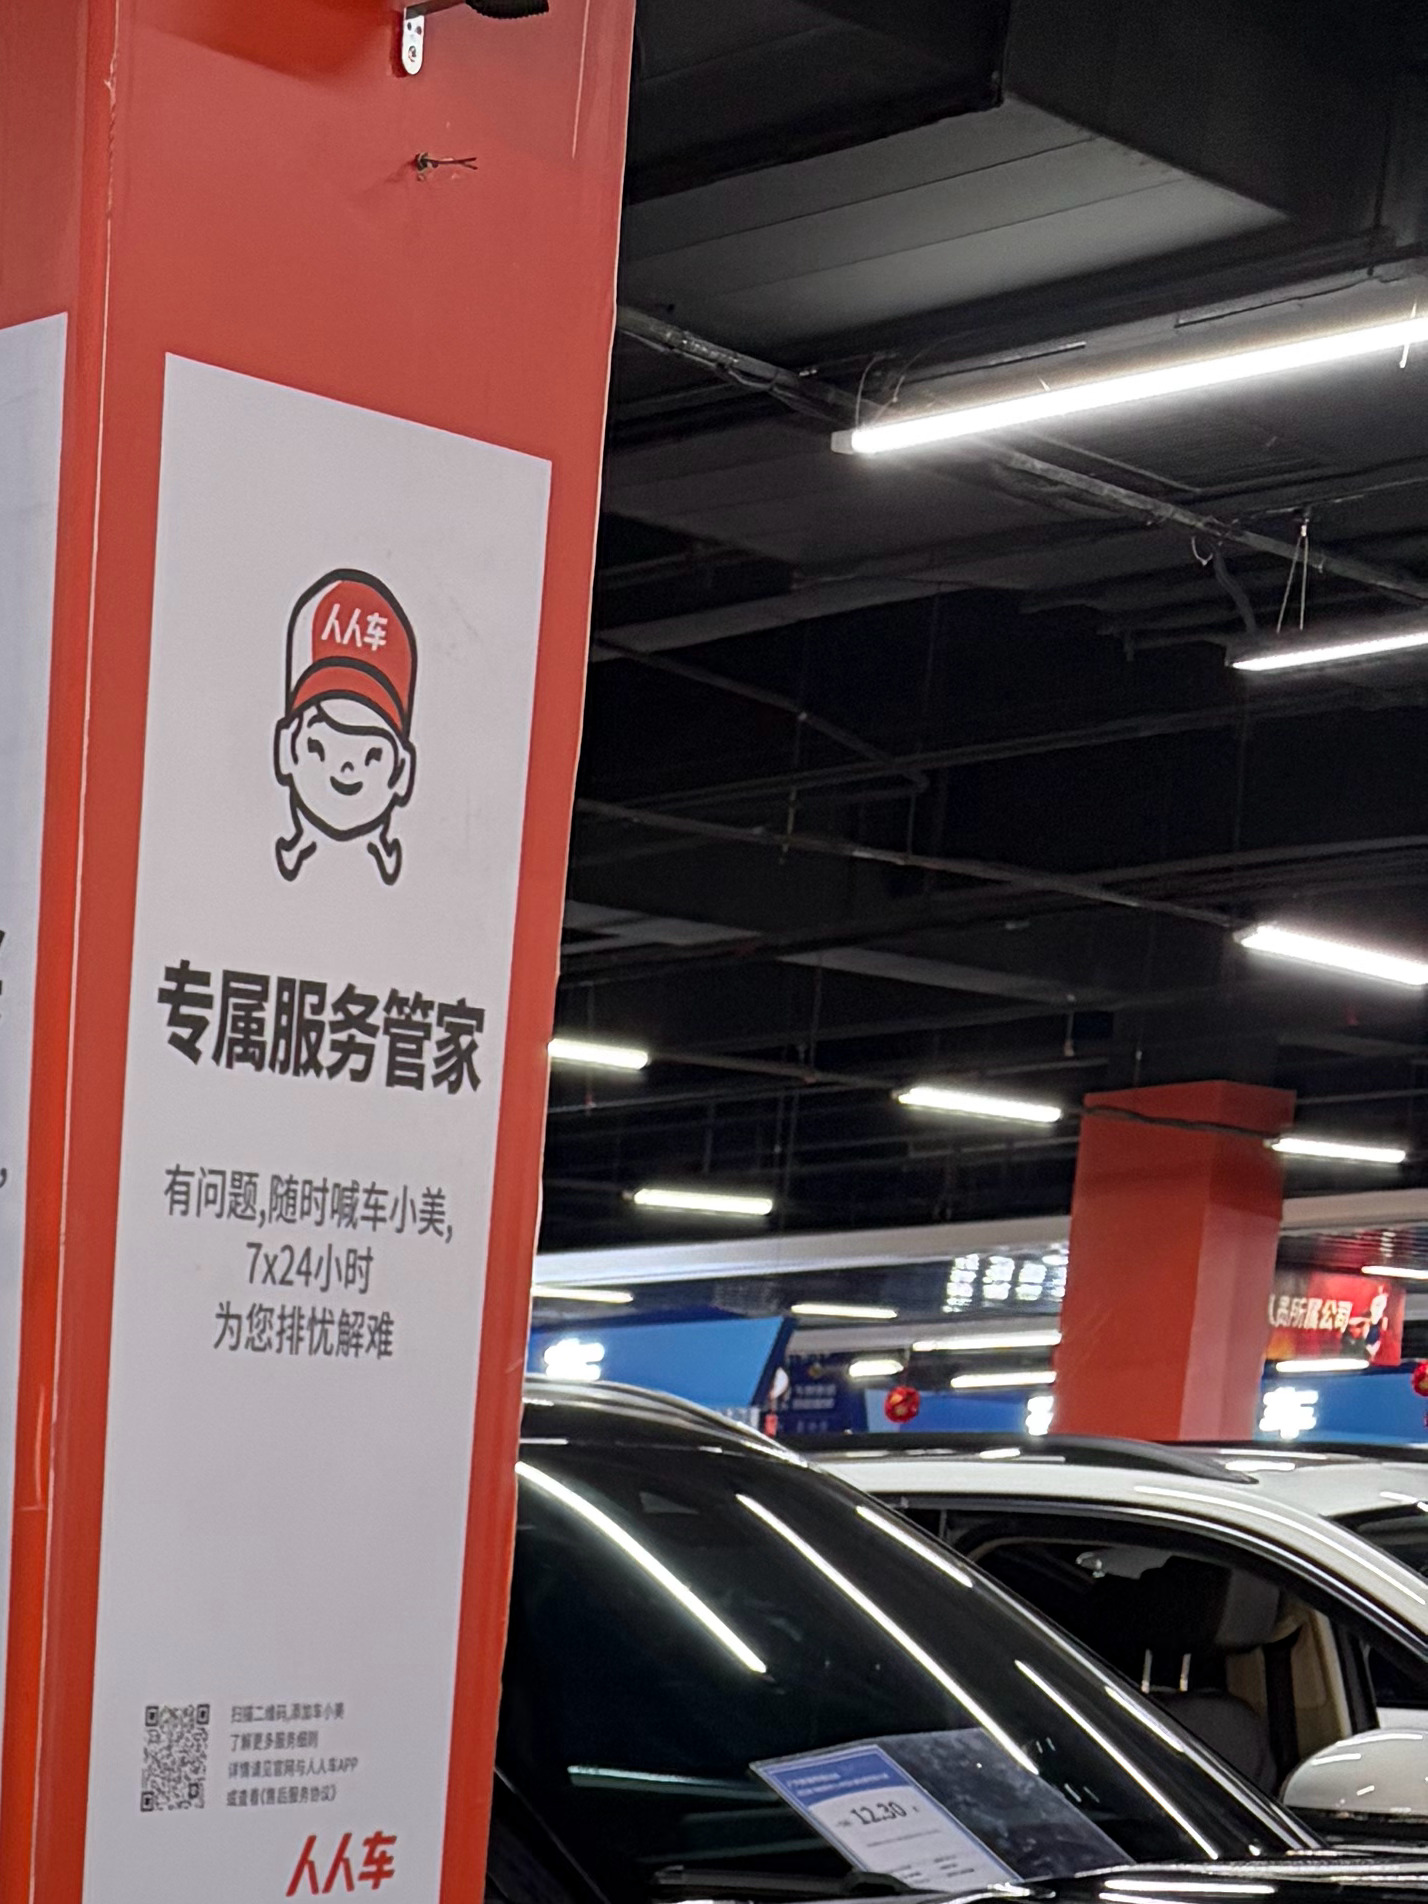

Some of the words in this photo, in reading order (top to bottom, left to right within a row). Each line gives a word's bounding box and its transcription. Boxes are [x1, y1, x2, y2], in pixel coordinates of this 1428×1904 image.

[321, 603, 389, 651] 人人车
[157, 959, 485, 1095] 专属服务管家
[164, 1163, 454, 1243] 有问题,随时喊车小美,
[246, 1242, 374, 1295] 7x24小时
[213, 1301, 395, 1360] 为您排忧解难
[285, 1830, 398, 1897] 人人车
